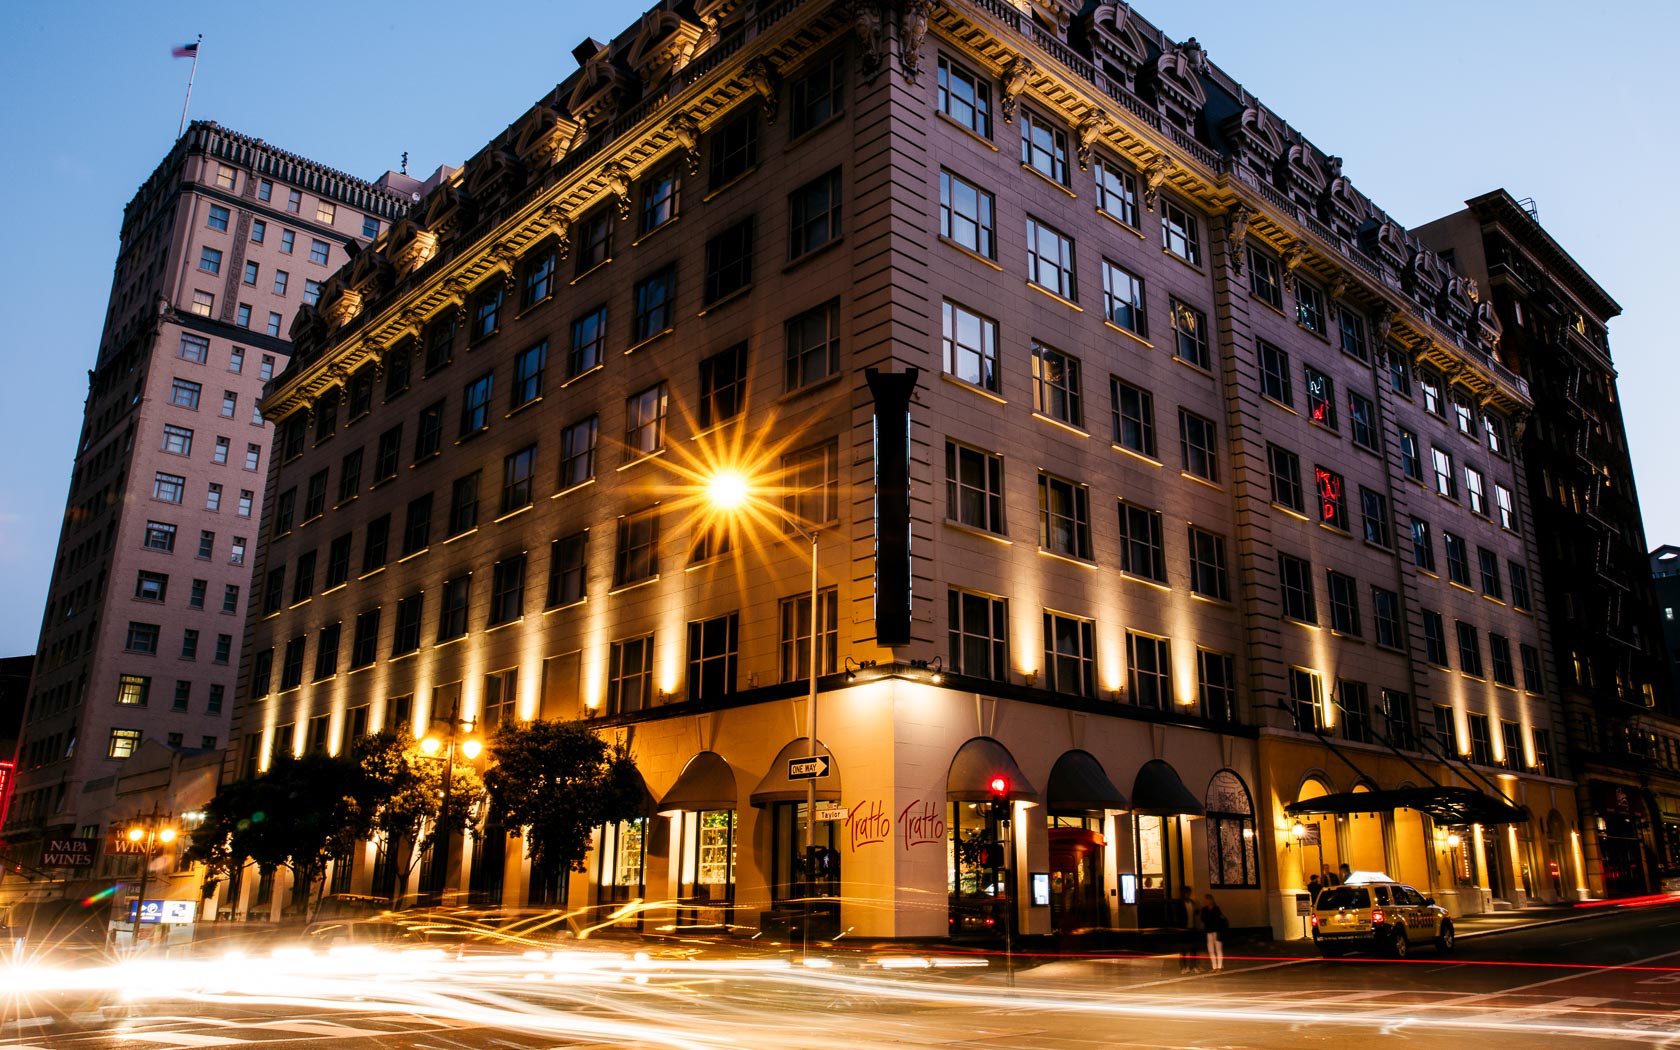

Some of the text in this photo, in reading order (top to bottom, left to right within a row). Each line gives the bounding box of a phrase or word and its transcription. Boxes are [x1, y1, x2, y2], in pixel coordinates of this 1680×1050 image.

[792, 763, 817, 774] ONE WAY
[821, 811, 841, 819] Taylor
[845, 800, 890, 852] Tratto
[898, 799, 943, 850] Tratto
[50, 840, 88, 852] NAPA
[44, 853, 92, 865] WINES
